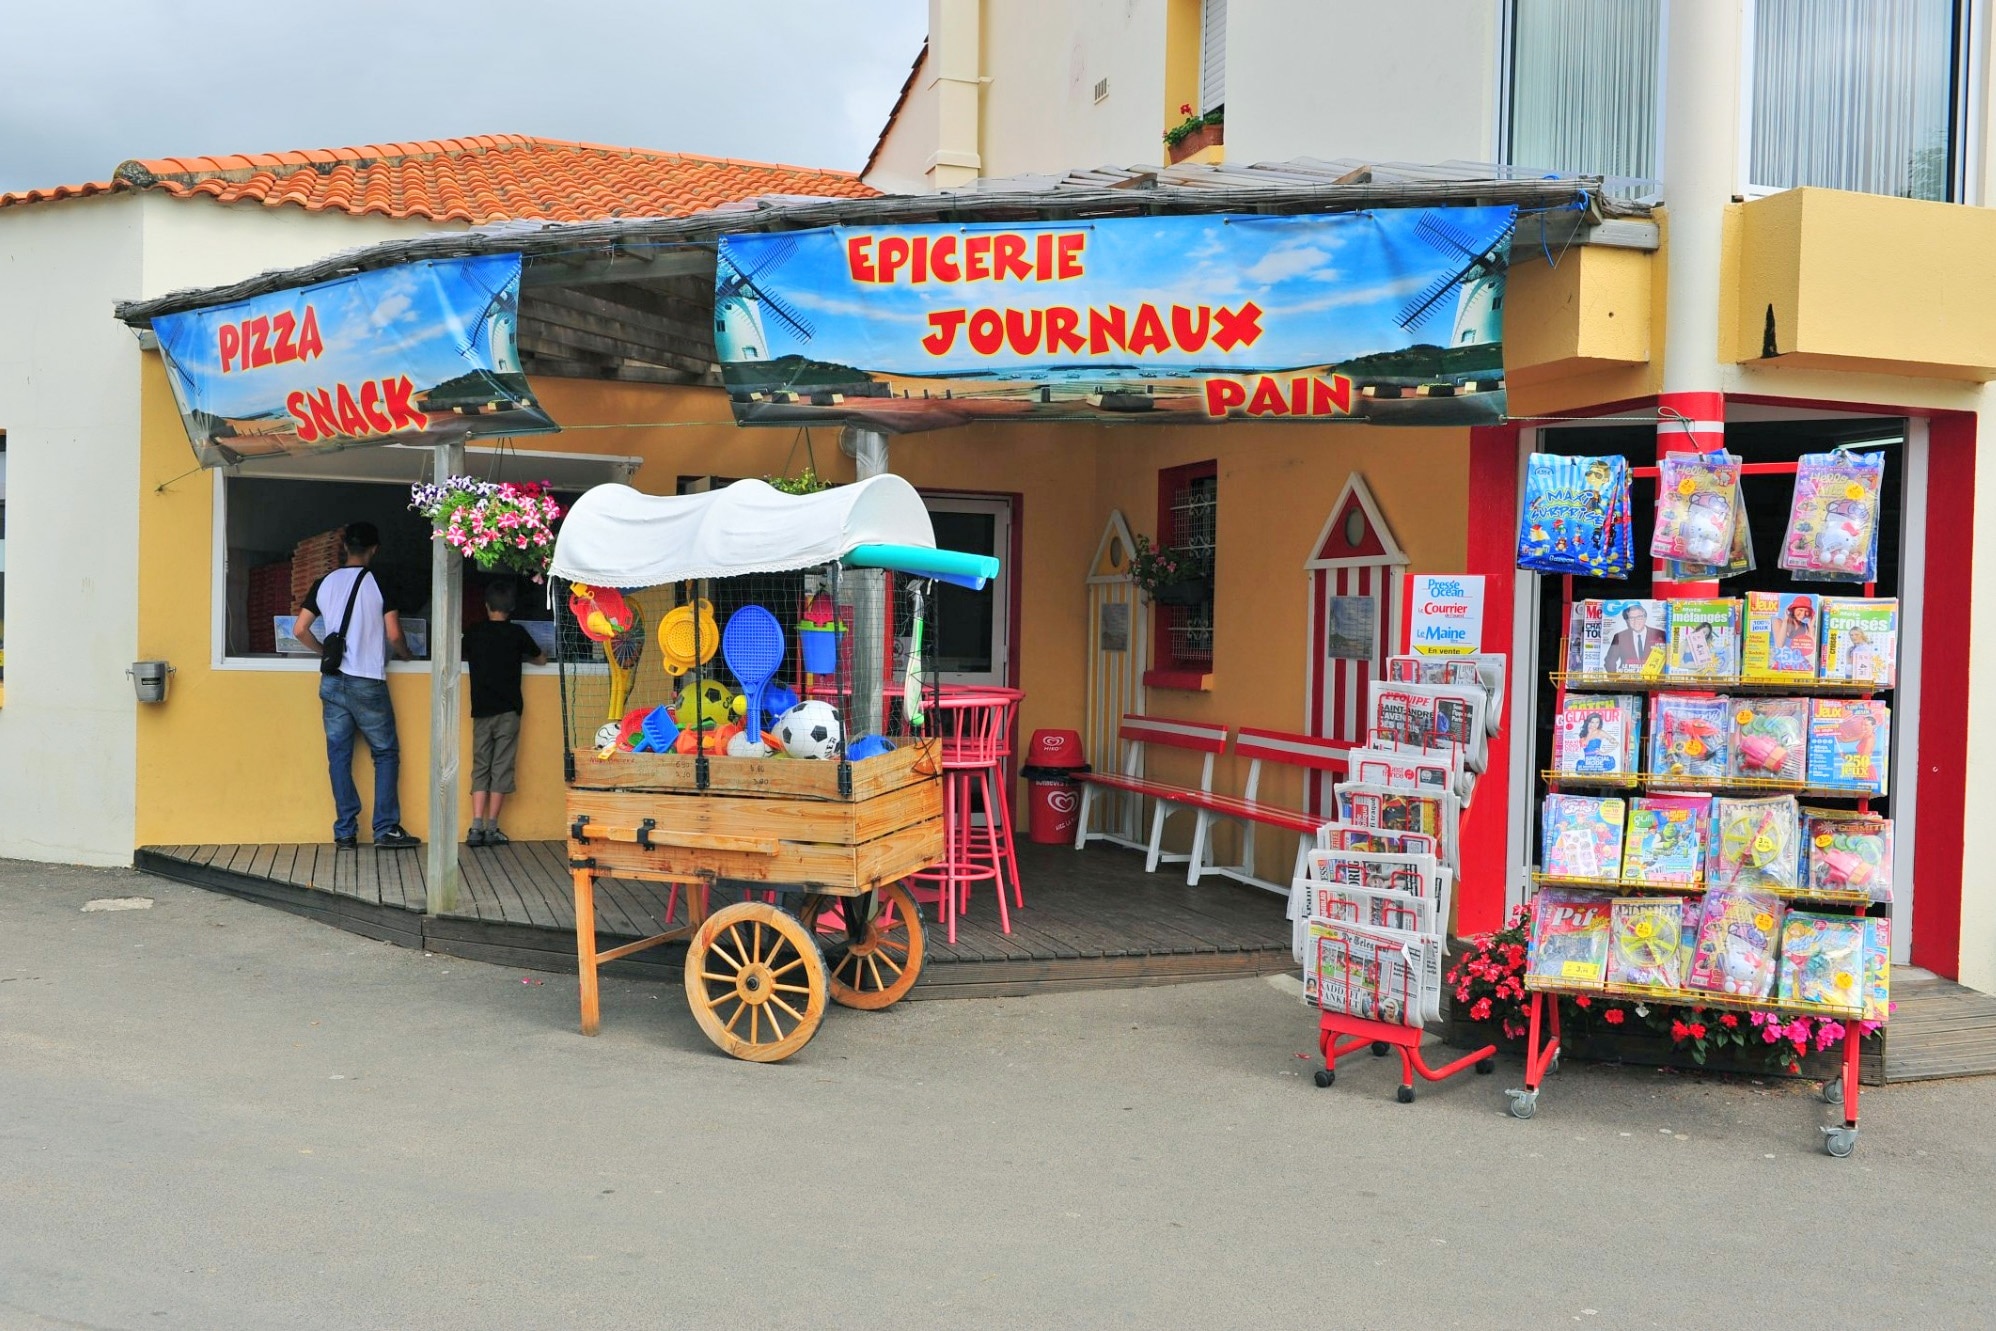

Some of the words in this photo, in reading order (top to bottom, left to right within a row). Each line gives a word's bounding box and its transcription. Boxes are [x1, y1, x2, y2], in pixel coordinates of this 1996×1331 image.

[847, 231, 1085, 285] EPICERIE
[921, 300, 1264, 357] JOURNAUX
[218, 305, 324, 373] PIZZA
[1204, 373, 1353, 418] PAIN
[286, 375, 429, 443] SNACK
[1427, 578, 1460, 590] Presse
[1424, 602, 1468, 615] Courrier
[1672, 612, 1728, 624] mélangés
[1830, 617, 1888, 631] croisés
[1425, 626, 1466, 640] Maine
[1440, 647, 1461, 655] vente
[1551, 907, 1598, 927] Pif
